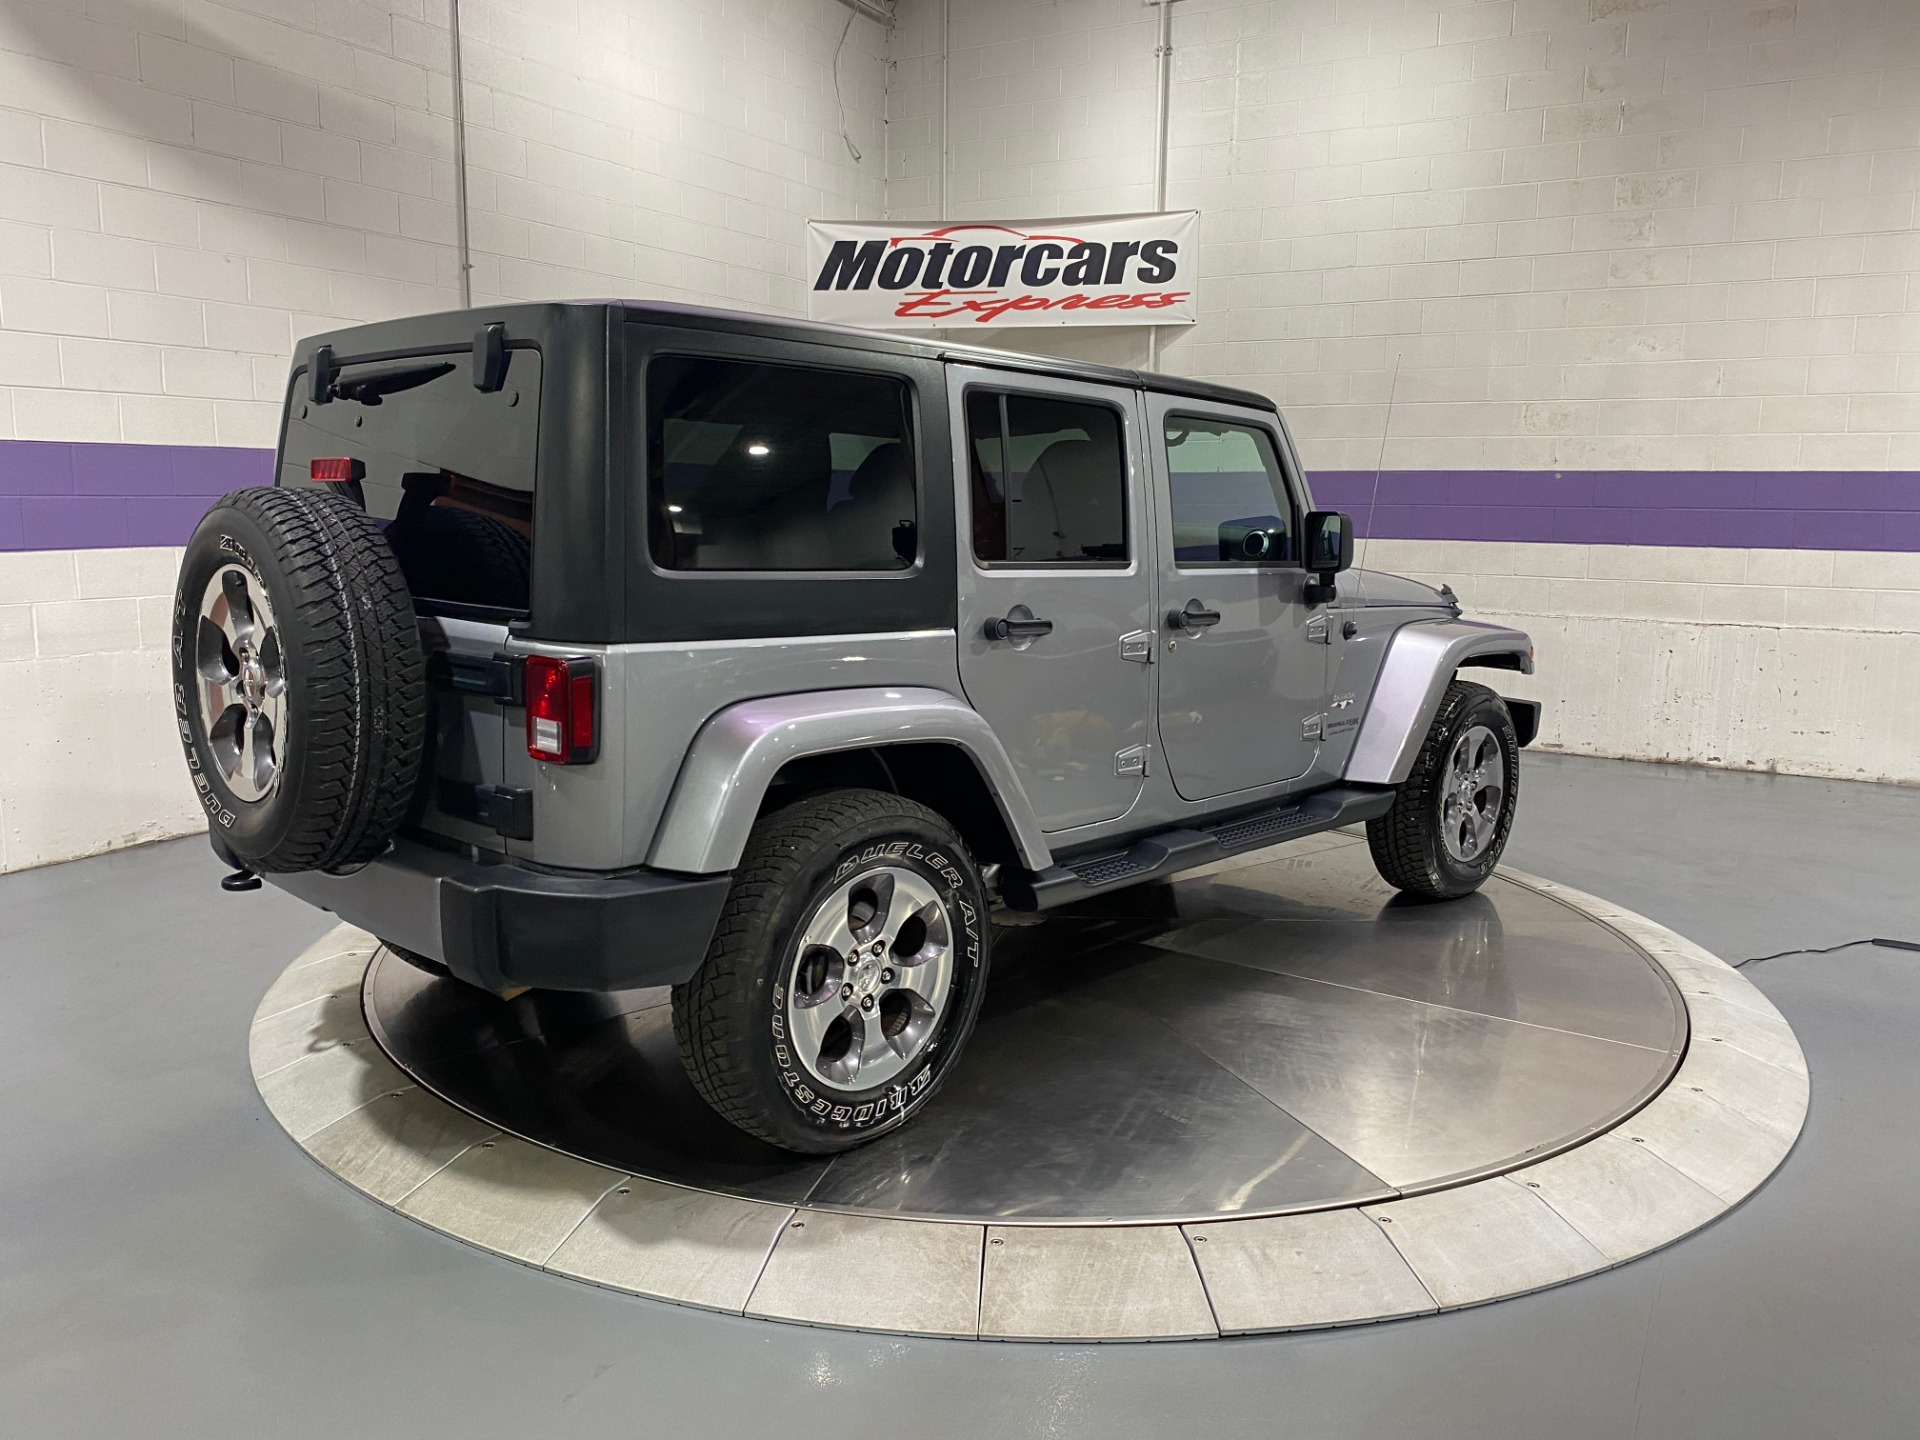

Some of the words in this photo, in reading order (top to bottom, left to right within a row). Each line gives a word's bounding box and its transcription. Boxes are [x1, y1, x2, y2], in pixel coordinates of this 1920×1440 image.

[894, 289, 1191, 323] Express
[175, 689, 236, 829] DUELER
[833, 841, 964, 890] DUELER
[958, 899, 980, 968] A/T
[772, 982, 933, 1124] BRIDGESTONE
